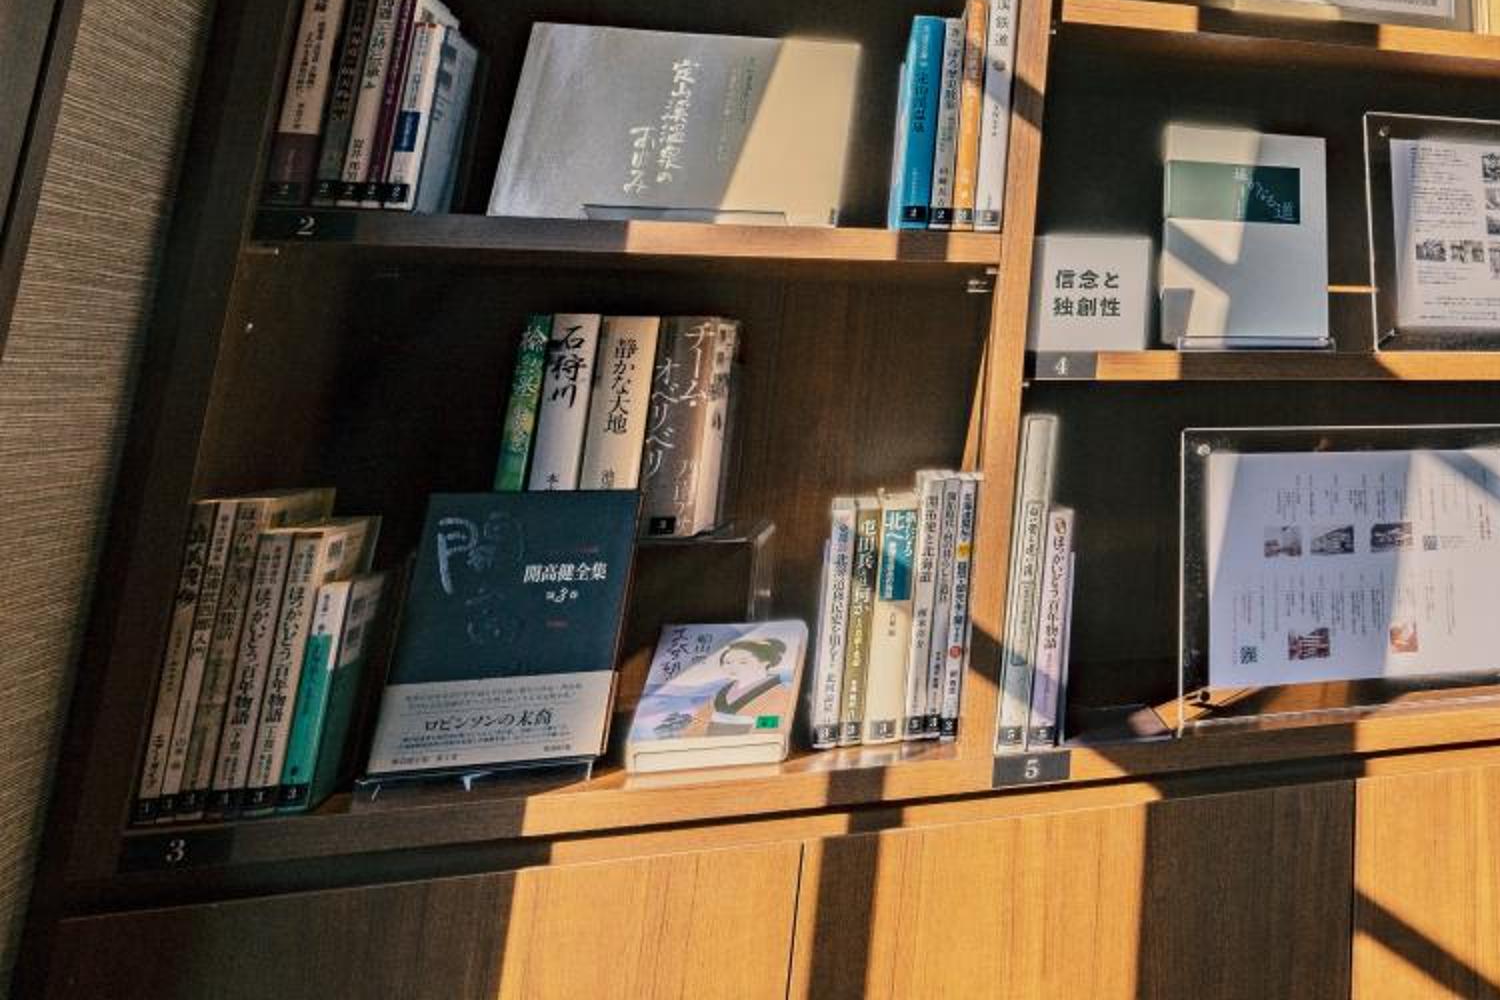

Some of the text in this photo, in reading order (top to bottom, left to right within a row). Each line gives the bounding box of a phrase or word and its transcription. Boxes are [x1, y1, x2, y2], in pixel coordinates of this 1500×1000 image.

[295, 217, 315, 236] 2
[1054, 268, 1120, 290] 信念と
[1052, 297, 1121, 318] 独創性
[550, 324, 587, 409] 石狩川
[1055, 357, 1069, 376] 4
[604, 337, 640, 435] 静かな大地
[523, 561, 608, 584] 開高健全集
[1025, 758, 1040, 779] 5
[165, 839, 186, 862] 3
